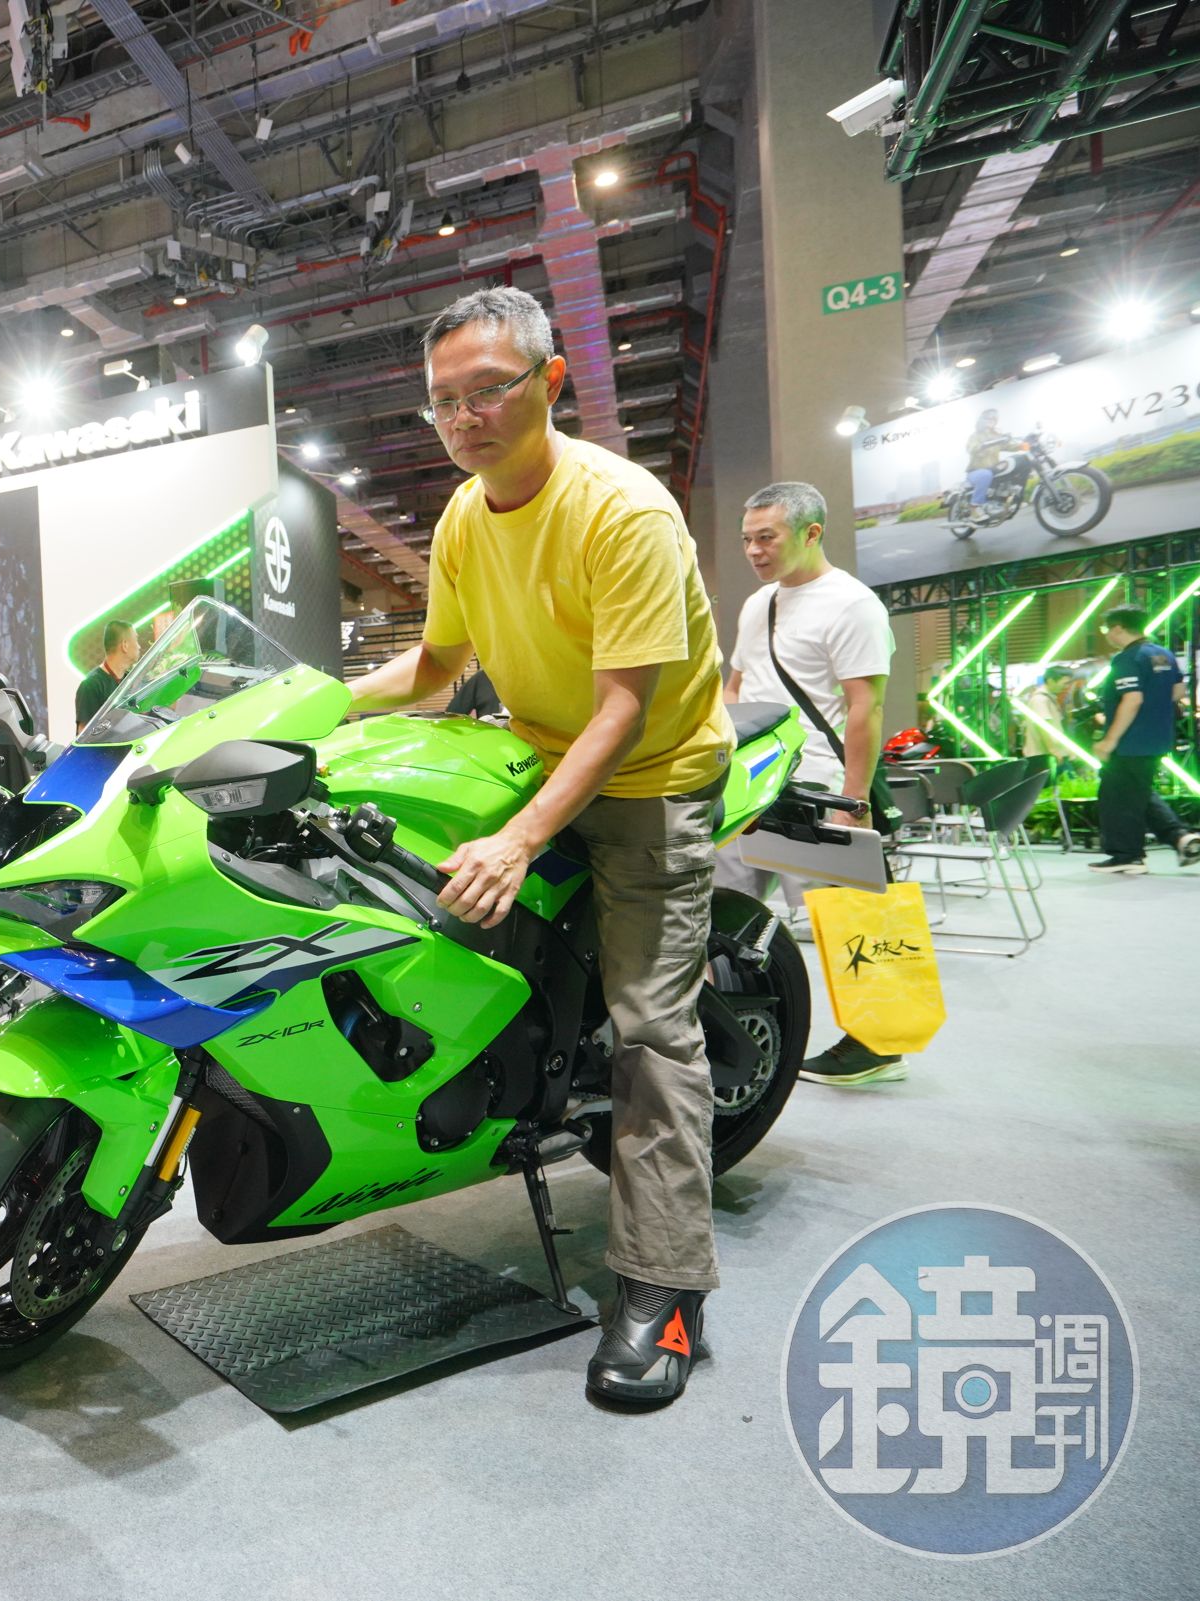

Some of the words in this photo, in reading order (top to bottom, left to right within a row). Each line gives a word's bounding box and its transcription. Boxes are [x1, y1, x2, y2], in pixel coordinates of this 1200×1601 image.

[827, 276, 897, 310] Q4-3
[1101, 382, 1200, 423] W23
[172, 921, 351, 982] ZX
[236, 1019, 326, 1048] ZX-10R
[300, 1167, 444, 1218] Ninja
